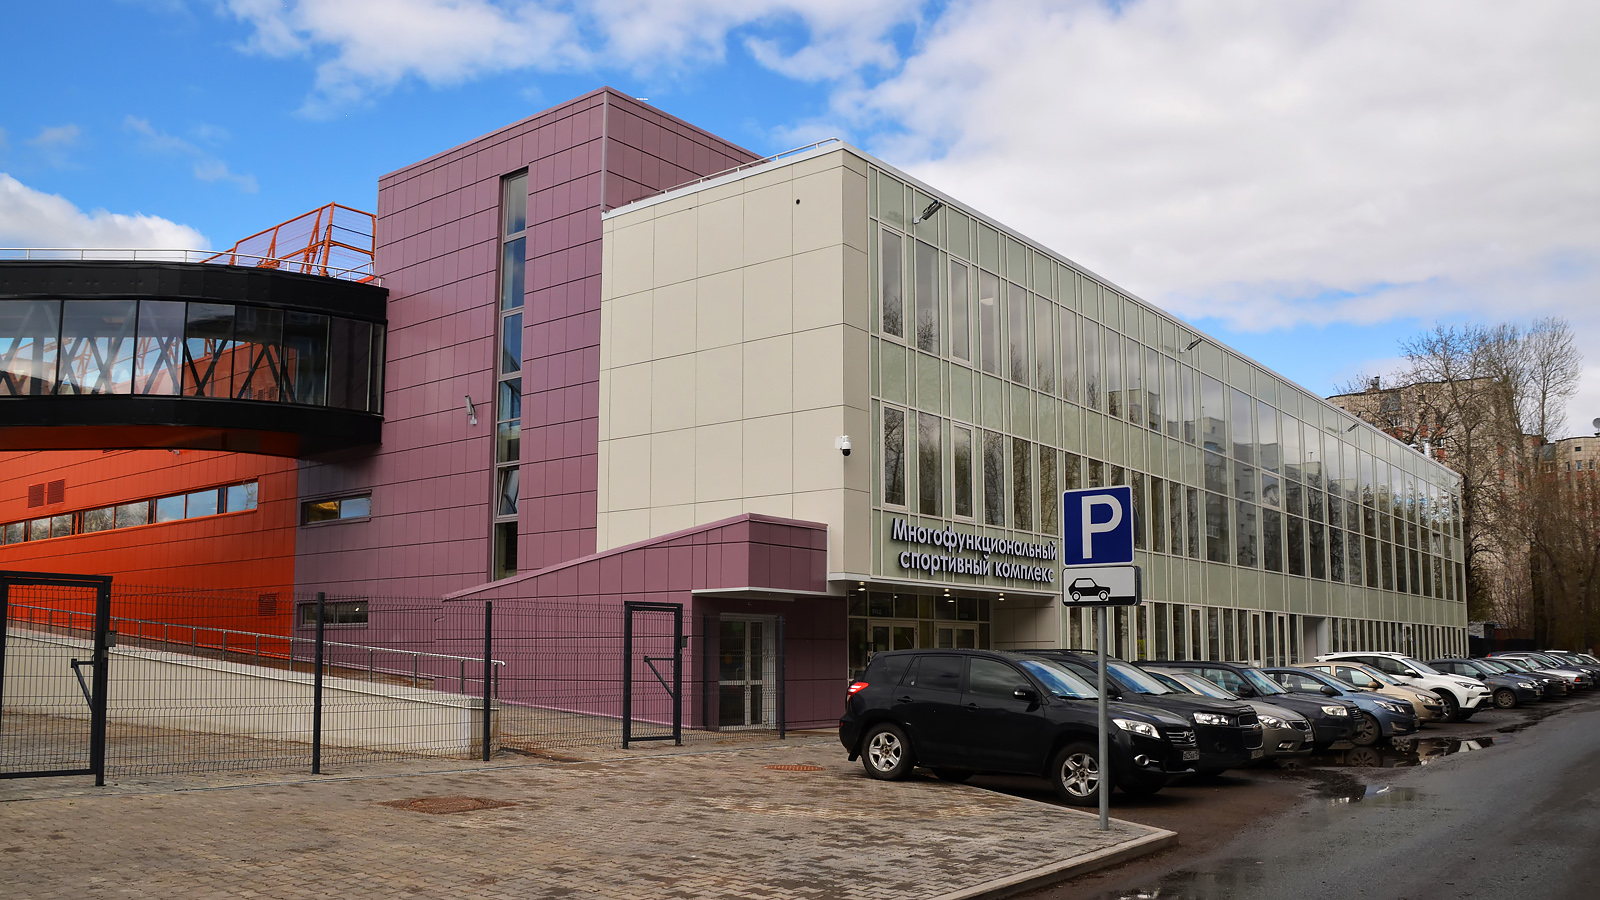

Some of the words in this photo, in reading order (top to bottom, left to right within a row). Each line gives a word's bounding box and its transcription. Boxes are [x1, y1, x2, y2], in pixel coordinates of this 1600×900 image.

[892, 518, 1057, 560] Многофункциональный
[1082, 494, 1123, 559] P
[900, 551, 990, 576] спортивный
[994, 561, 1055, 583] комплекс
